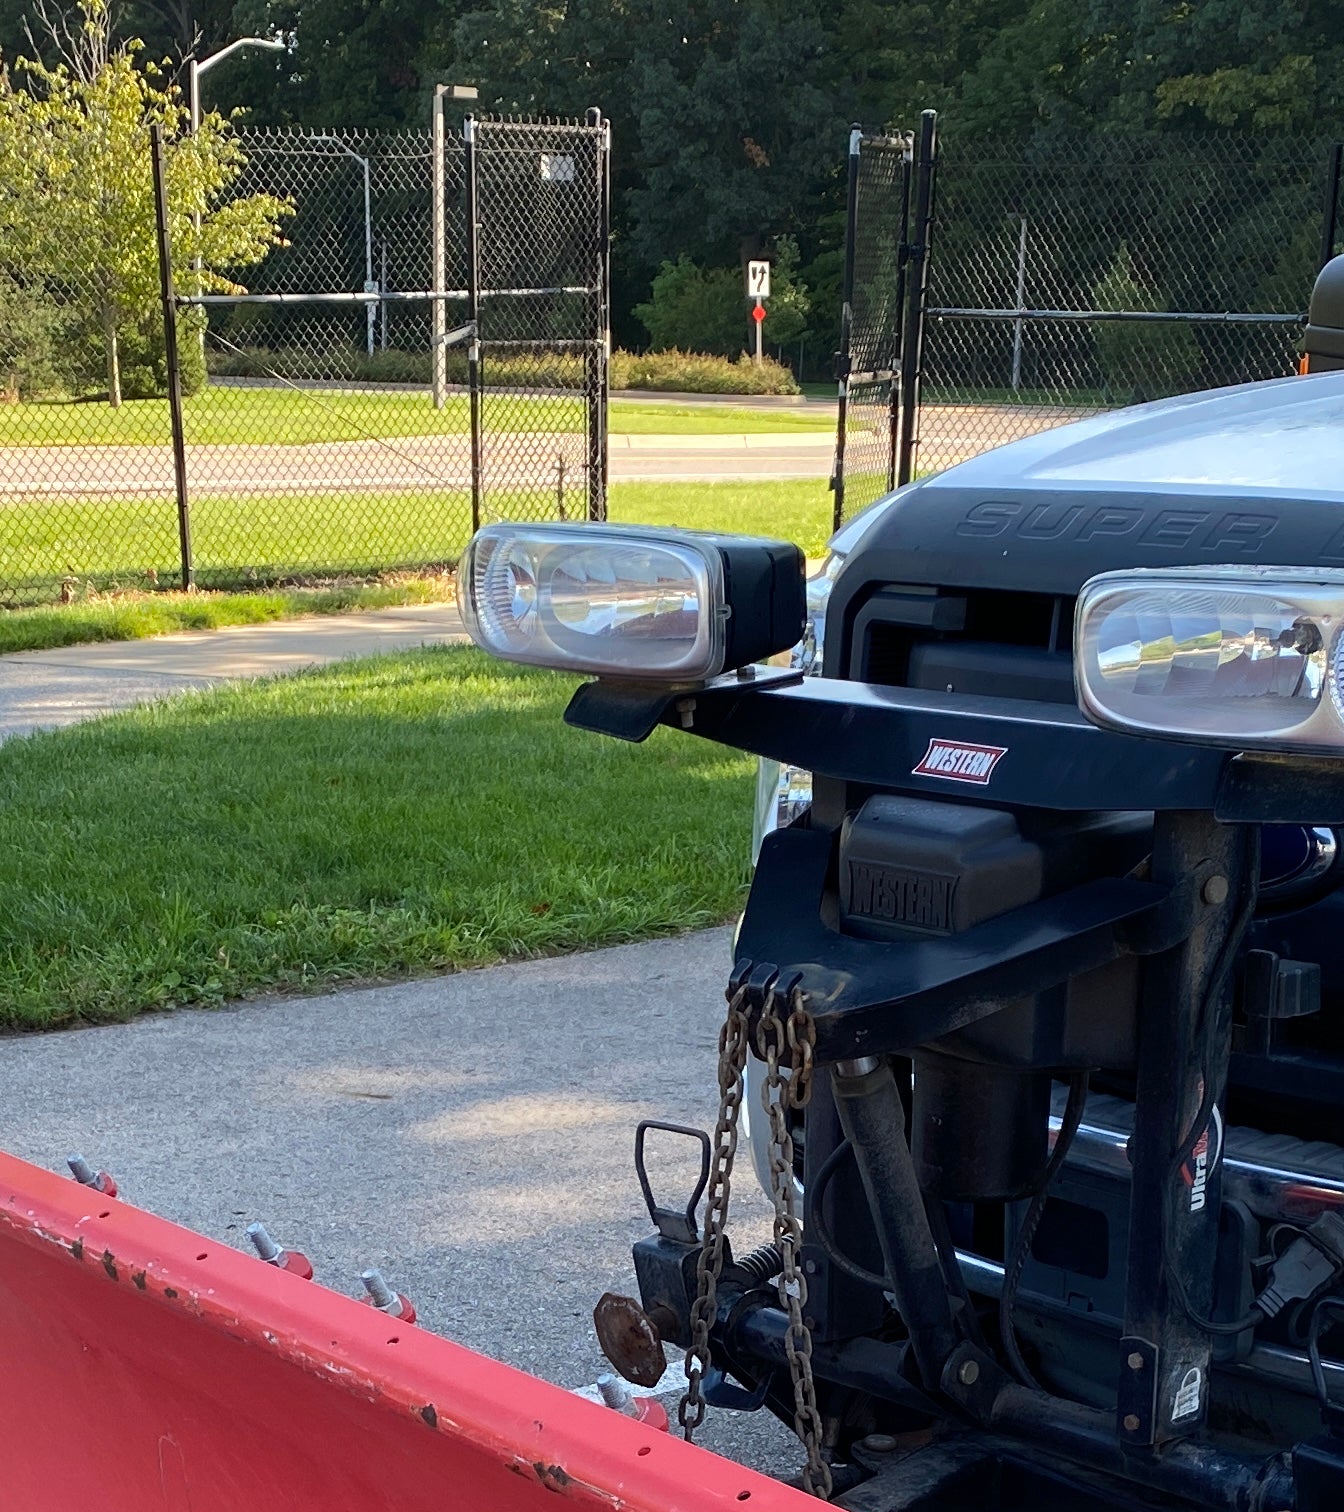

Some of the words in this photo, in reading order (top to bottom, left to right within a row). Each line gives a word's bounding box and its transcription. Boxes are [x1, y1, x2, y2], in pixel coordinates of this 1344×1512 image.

[957, 500, 1280, 553] SUPER
[924, 745, 996, 777] WESTERN
[858, 866, 953, 929] WESTERN
